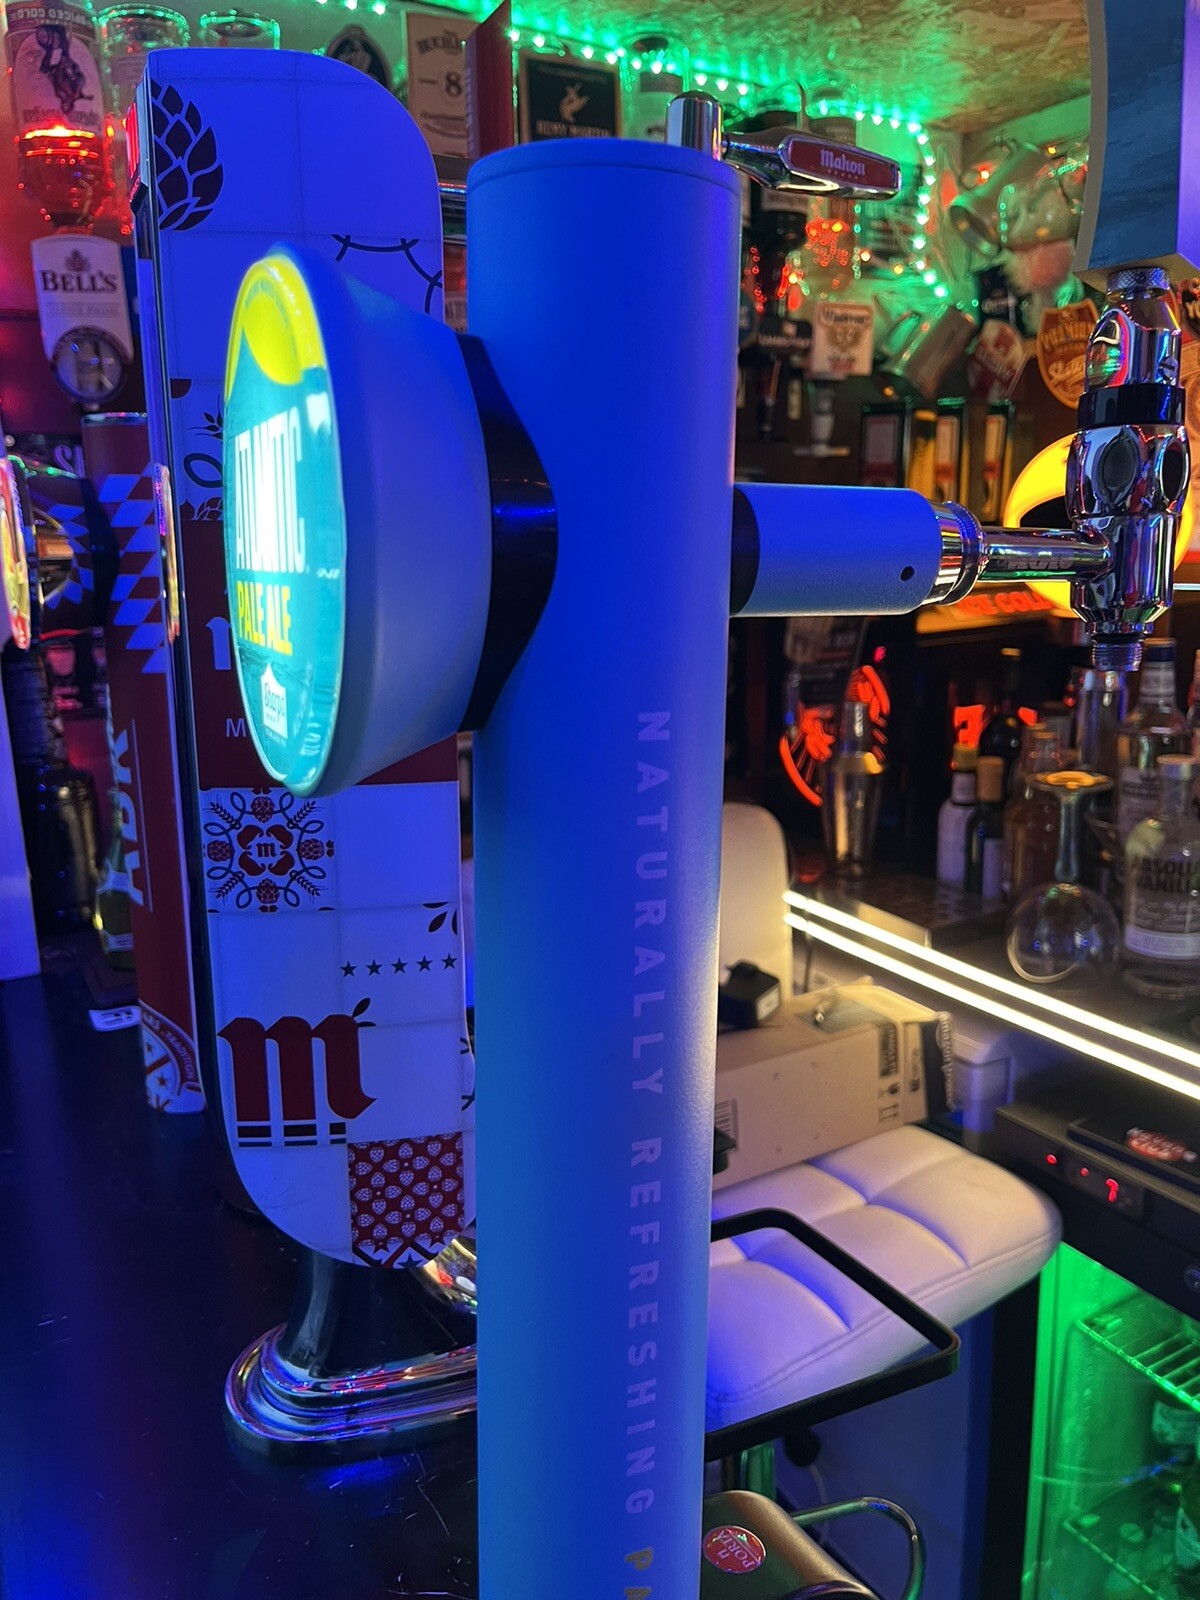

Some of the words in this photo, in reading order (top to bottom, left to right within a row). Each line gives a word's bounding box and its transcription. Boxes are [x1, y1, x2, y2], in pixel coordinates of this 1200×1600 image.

[820, 149, 866, 176] Mahou
[40, 268, 119, 293] BELL'S
[236, 580, 266, 647] PALE
[265, 584, 293, 656] ALE
[632, 711, 672, 1095] NATURALLY
[624, 1136, 663, 1515] REFRESHING
[714, 1530, 756, 1568] PORTA
